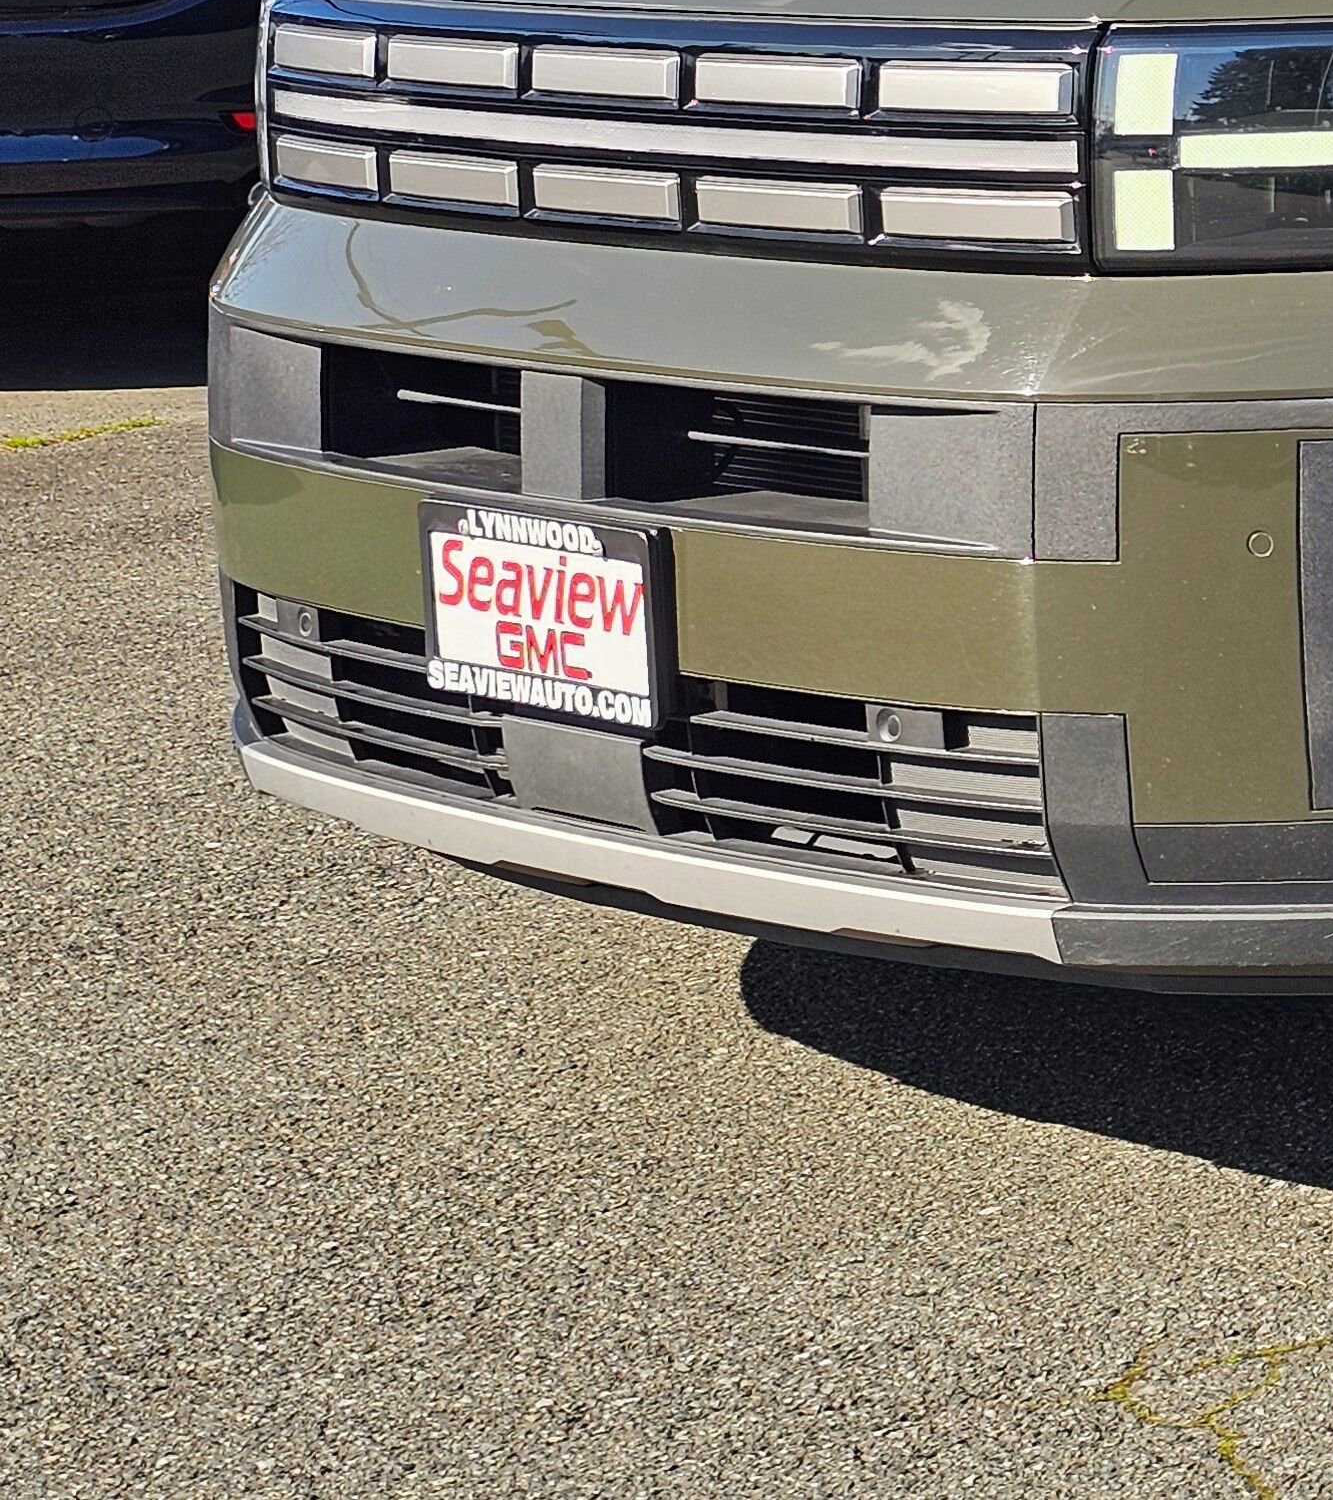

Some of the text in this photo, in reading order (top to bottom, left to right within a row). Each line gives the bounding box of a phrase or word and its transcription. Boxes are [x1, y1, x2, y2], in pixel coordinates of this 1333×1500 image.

[465, 508, 597, 555] LYNNWOOD
[438, 539, 645, 636] Seaview
[496, 619, 593, 680] GMC
[427, 659, 652, 728] SEAVIEWAUTO.COM
